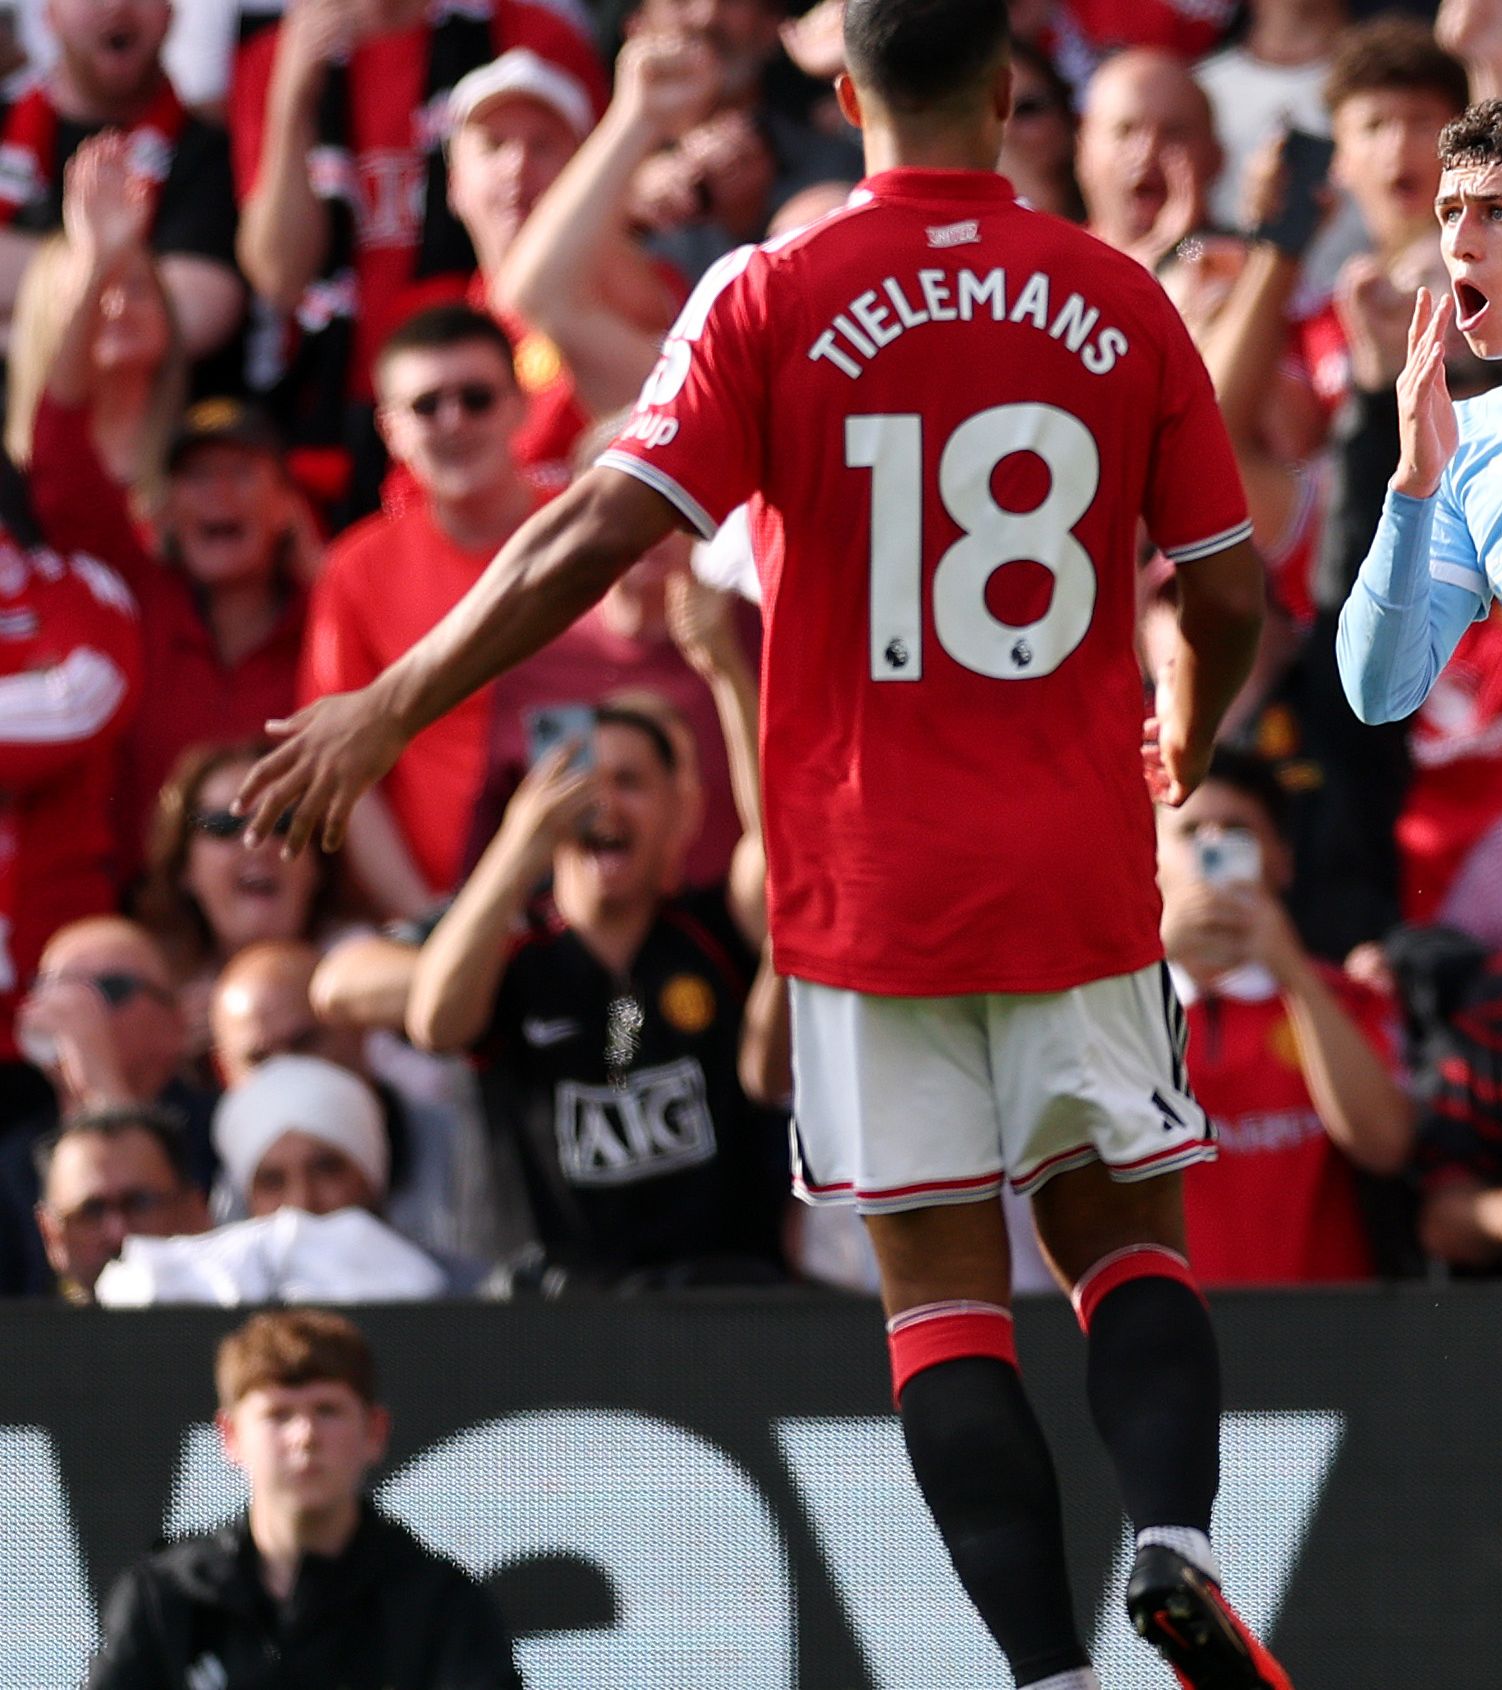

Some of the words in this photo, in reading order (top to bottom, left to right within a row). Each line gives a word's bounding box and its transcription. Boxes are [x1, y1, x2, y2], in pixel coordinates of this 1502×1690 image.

[808, 268, 1128, 379] TIELEMANS
[844, 401, 1099, 682] 18
[572, 1076, 706, 1172] AIG
